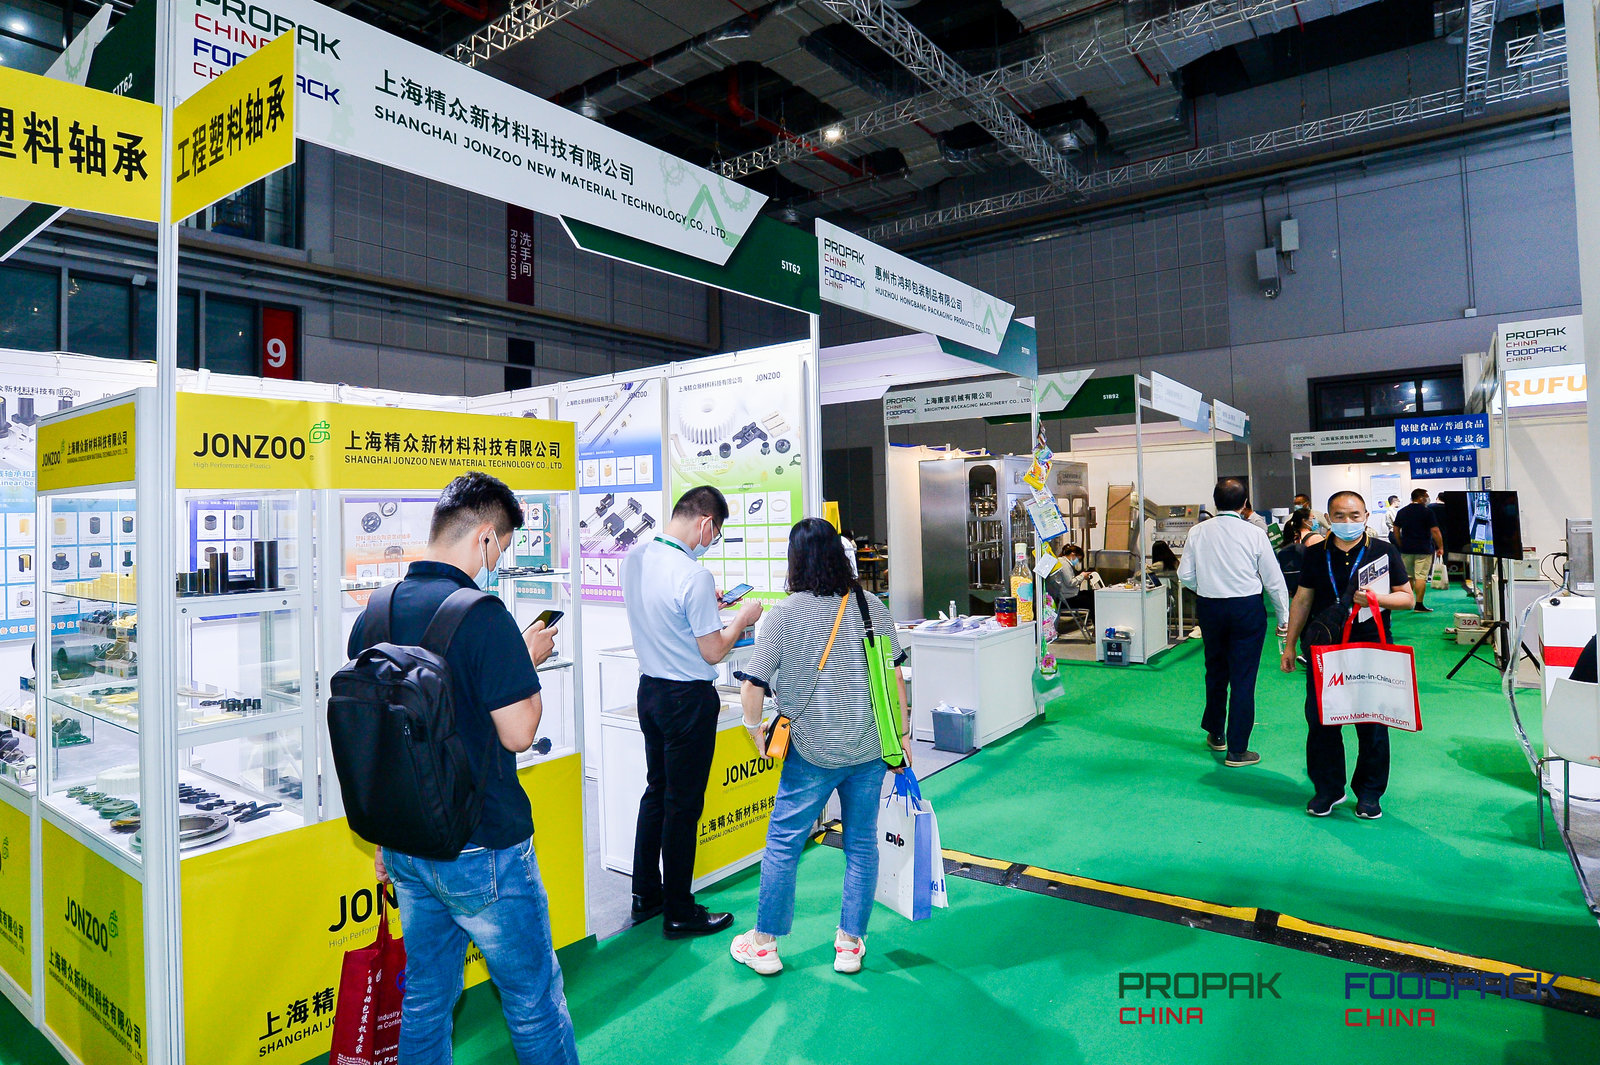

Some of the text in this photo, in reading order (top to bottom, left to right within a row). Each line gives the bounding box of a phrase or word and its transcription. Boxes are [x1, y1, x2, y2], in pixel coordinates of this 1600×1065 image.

[176, 74, 286, 183] 工程塑料轴承
[374, 68, 634, 186] 上海精众新材料科技有限公司
[374, 105, 729, 240] SHANGHAI JONZOO NEW MATERIAL TECHNOLOGY CO., LTD.
[520, 232, 532, 276] 洗手间
[824, 238, 865, 266] PROPAK
[824, 254, 846, 268] CHINA
[782, 260, 801, 275] 51T62
[824, 266, 866, 290] FOODPACK
[824, 278, 843, 290] CHINA
[874, 265, 962, 312] 惠州市鸿邦包装制品有限公司
[875, 287, 898, 301] HUIZHOU
[900, 296, 927, 311] HONGBANG
[928, 306, 953, 320] PACKAGING
[954, 316, 975, 329] PRODUCTS
[1506, 327, 1566, 341] PROPAK
[1506, 340, 1538, 348] CHINA
[266, 338, 287, 368] 9
[1506, 345, 1567, 356] FOODPACK
[756, 371, 781, 382] JONZOO
[1401, 420, 1484, 432] 保健食品/普通食品
[193, 432, 306, 460] JONZOO
[345, 430, 560, 459] 上海精众新材料科技有限公司
[42, 451, 60, 467] JONZOO
[345, 455, 392, 464] SHANGHAI
[393, 456, 428, 465] JONZOO
[430, 458, 447, 466] NEW
[449, 459, 486, 467] MATERIAL
[488, 460, 534, 468] TECHNOLOGY
[1330, 712, 1410, 726] www.Made-in-China.com
[700, 831, 721, 846] SHANGHAI
[723, 824, 739, 836] JONZOO
[749, 812, 767, 825] MATERIAL
[65, 896, 108, 952] JONZOO
[328, 936, 348, 948] High
[49, 946, 142, 1049] 上海精众新材料科技有限公司
[259, 987, 335, 1041] 上海精
[259, 1022, 323, 1058] SHANGHAI
